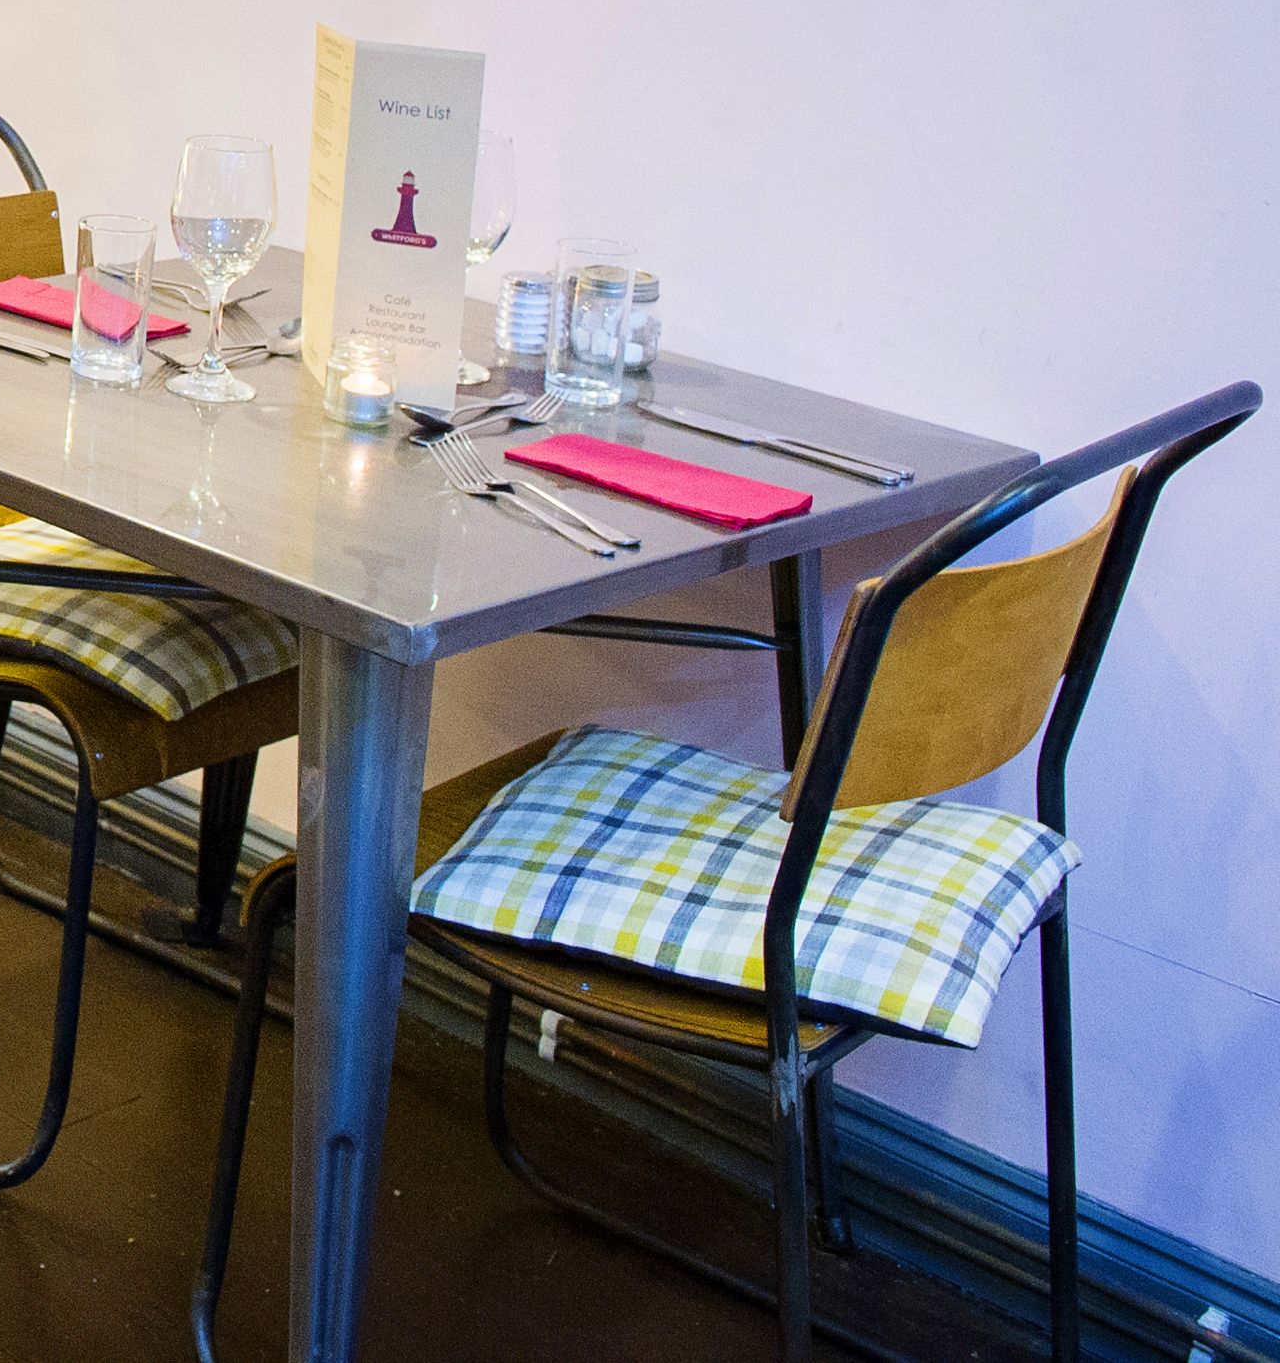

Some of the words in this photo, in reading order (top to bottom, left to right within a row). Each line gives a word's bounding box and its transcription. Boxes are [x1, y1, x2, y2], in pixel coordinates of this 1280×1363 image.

[379, 99, 421, 117] Wine
[426, 104, 451, 120] List
[384, 294, 412, 306] Café
[368, 304, 426, 320] Restaurant
[365, 317, 406, 332] Lounge
[409, 323, 427, 334] Bar
